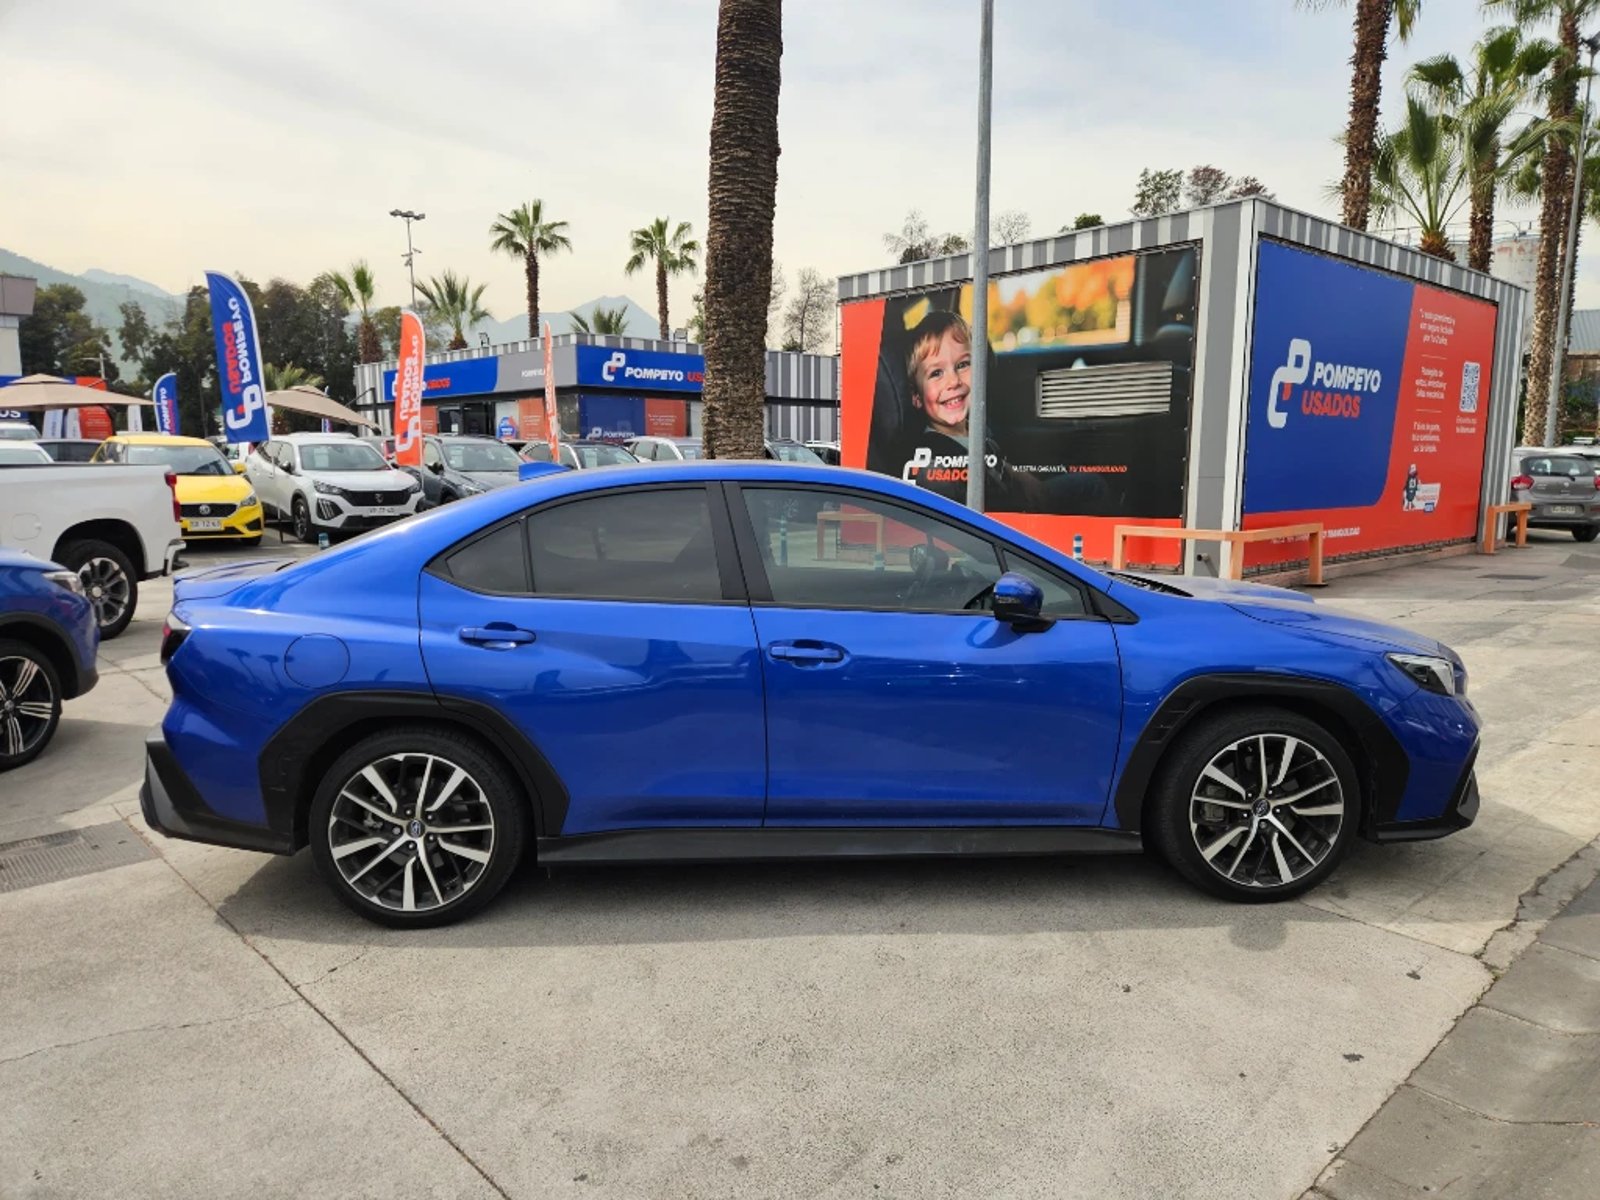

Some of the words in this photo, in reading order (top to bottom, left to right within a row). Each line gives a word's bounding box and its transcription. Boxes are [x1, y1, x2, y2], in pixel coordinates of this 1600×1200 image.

[625, 366, 684, 382] POMPEYO
[1312, 361, 1381, 393] POMPEYO
[1301, 390, 1361, 418] USADOS
[927, 468, 969, 481] USADO
